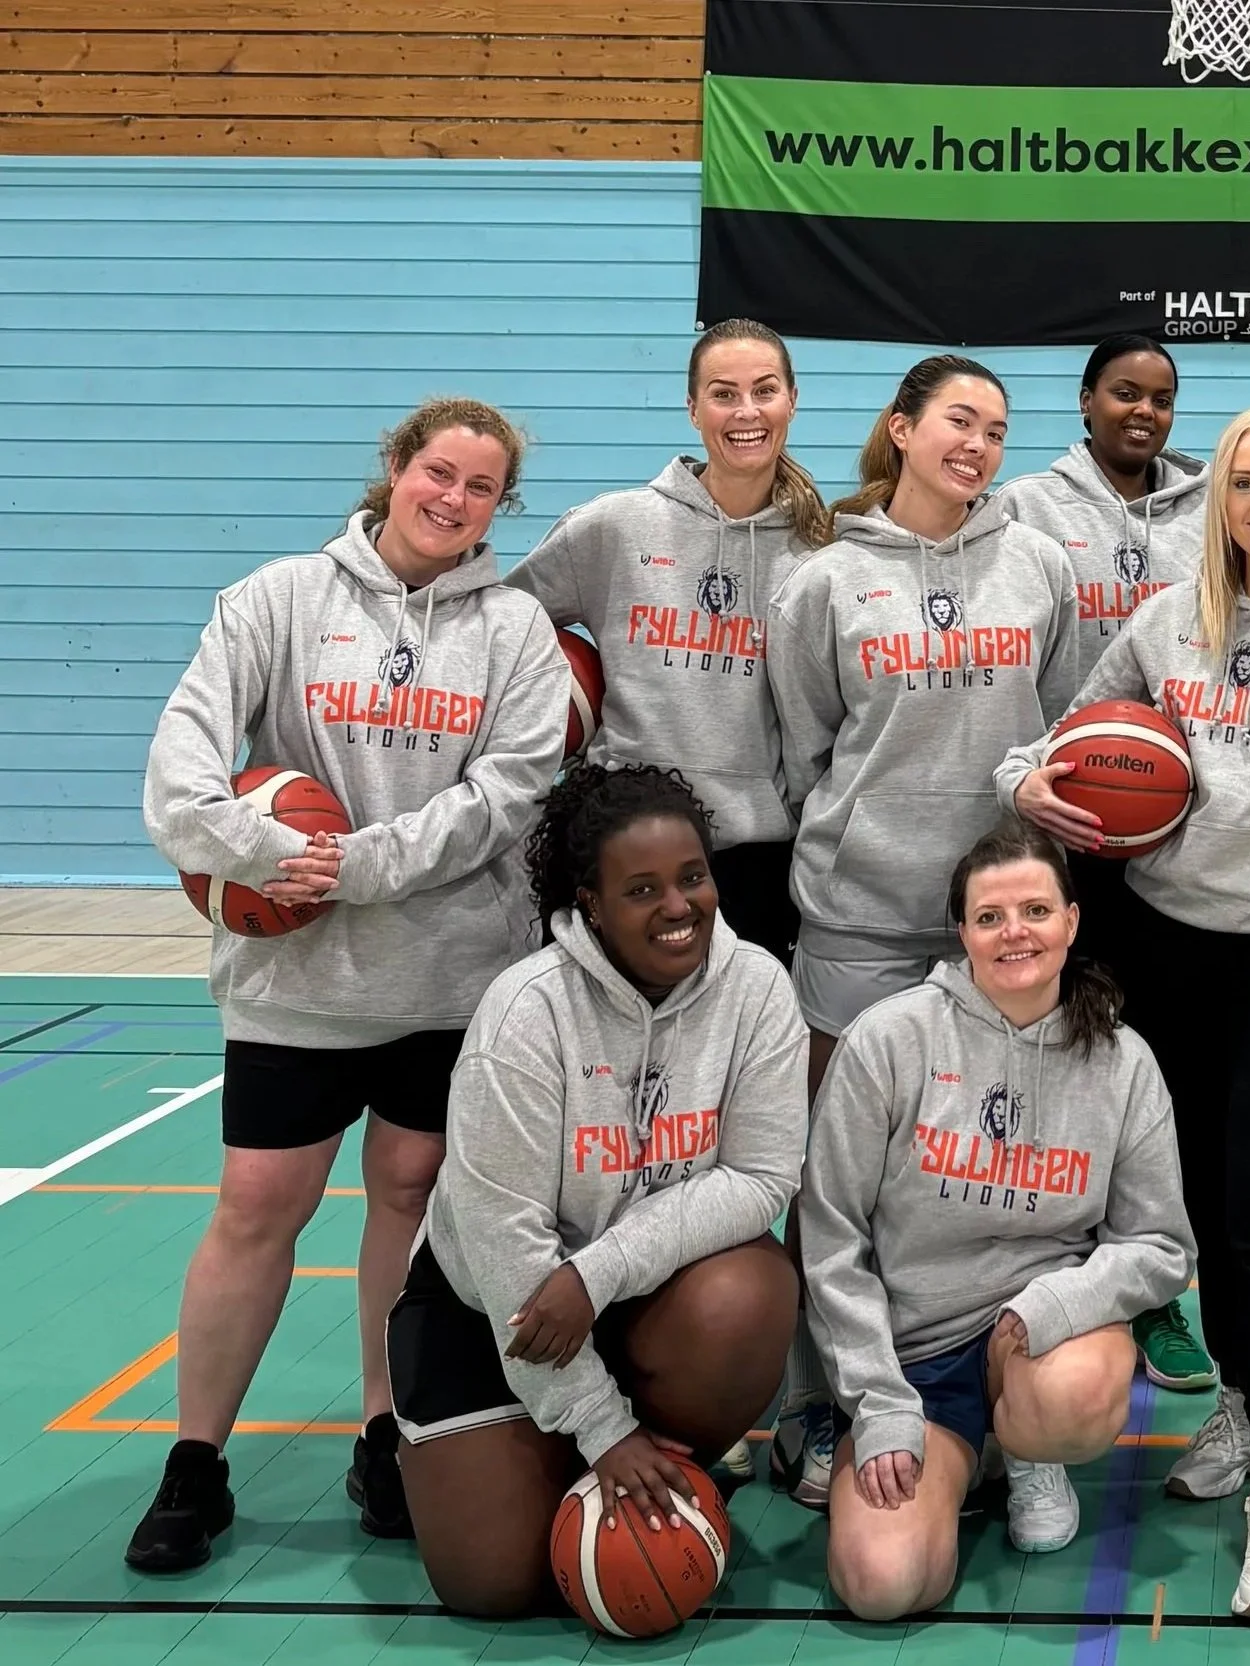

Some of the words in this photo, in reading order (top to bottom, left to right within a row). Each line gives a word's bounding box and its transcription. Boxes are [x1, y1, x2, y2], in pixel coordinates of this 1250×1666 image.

[1119, 291, 1142, 301] Part
[1143, 290, 1156, 301] of
[1164, 320, 1238, 336] GROUP
[628, 604, 767, 660] FYLLING
[663, 648, 756, 677] LIONS
[1084, 752, 1156, 776] molten
[939, 1178, 1038, 1212] LIONS
